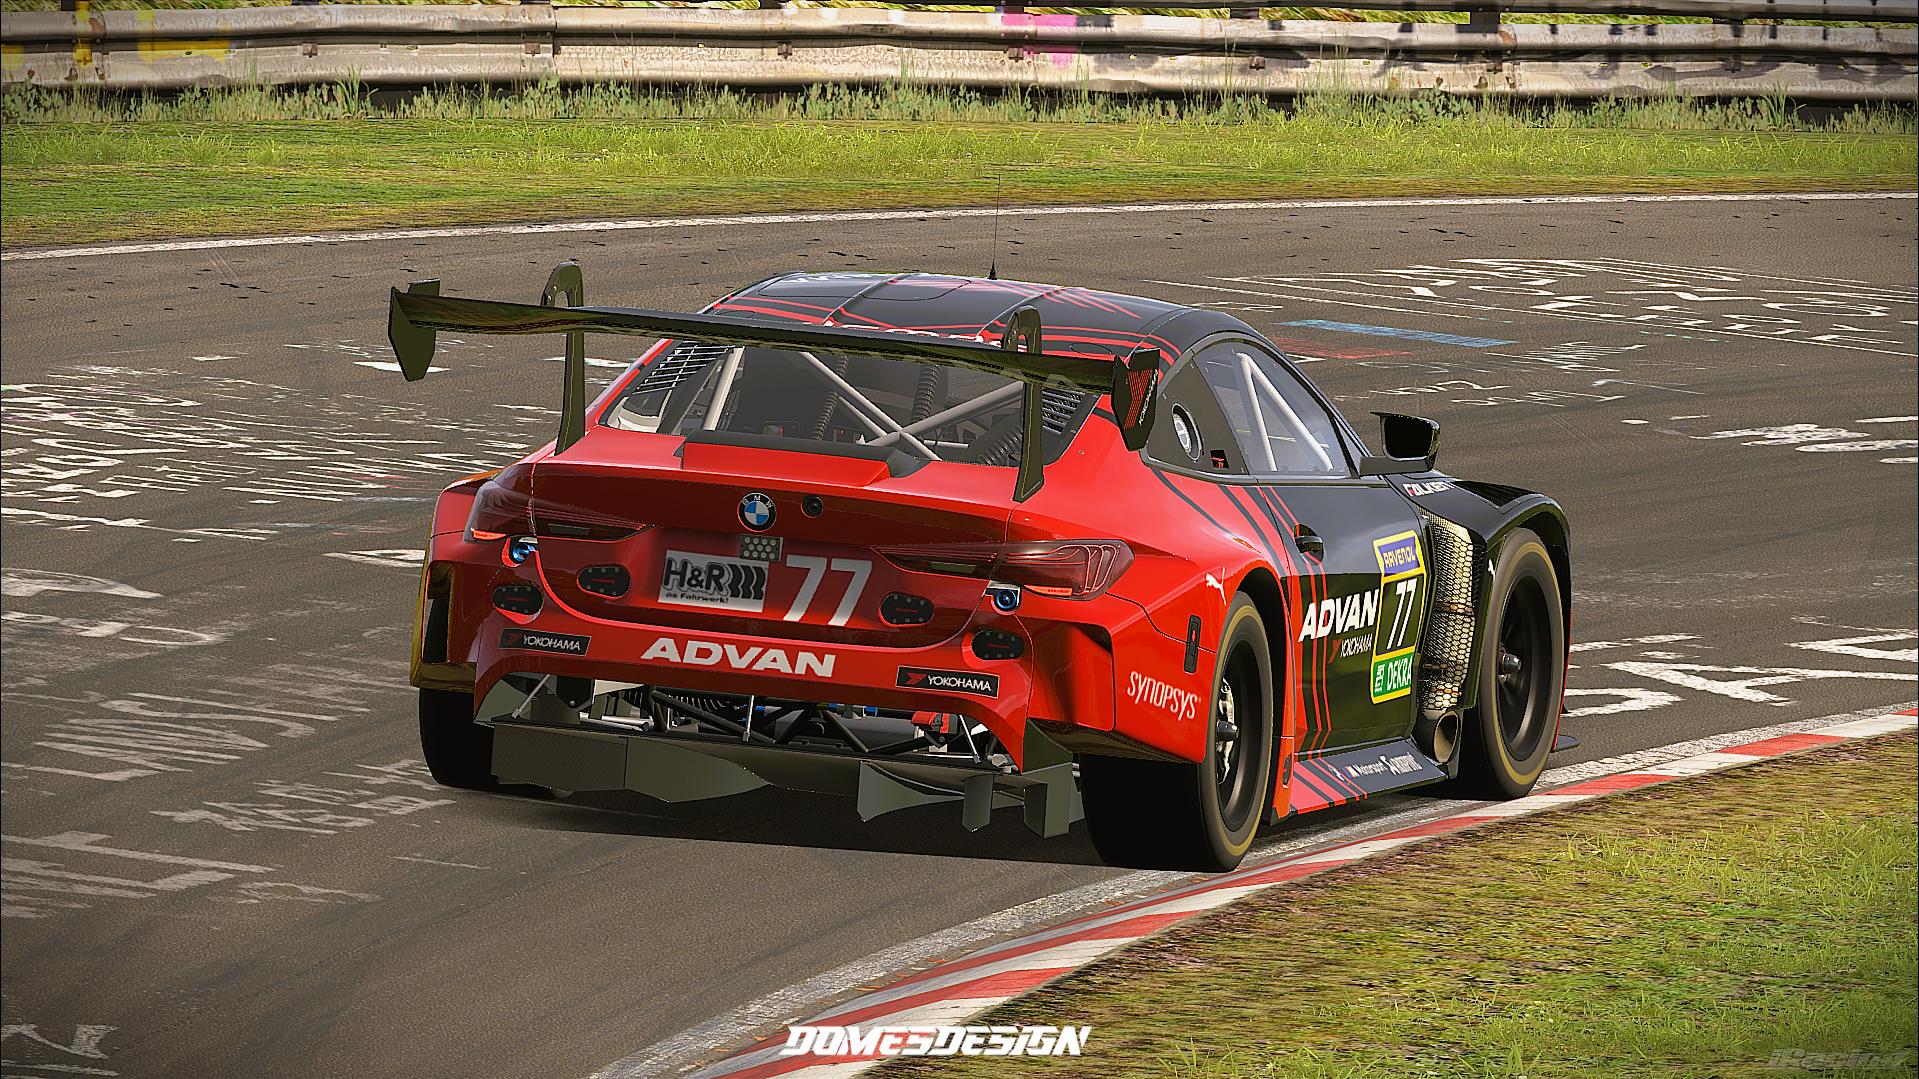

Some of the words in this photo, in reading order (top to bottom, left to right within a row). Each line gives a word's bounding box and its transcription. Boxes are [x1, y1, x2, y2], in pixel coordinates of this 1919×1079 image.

[663, 557, 728, 596] H&R
[783, 554, 873, 627] 77
[1297, 588, 1380, 643] ADVAN
[1386, 578, 1418, 651] 77
[523, 635, 581, 651] YOKOHAMA
[640, 637, 836, 678] ADVAN
[1339, 633, 1373, 659] YOKOHAMA
[928, 675, 992, 692] YOKOHAMA
[1386, 655, 1413, 691] DEKRA
